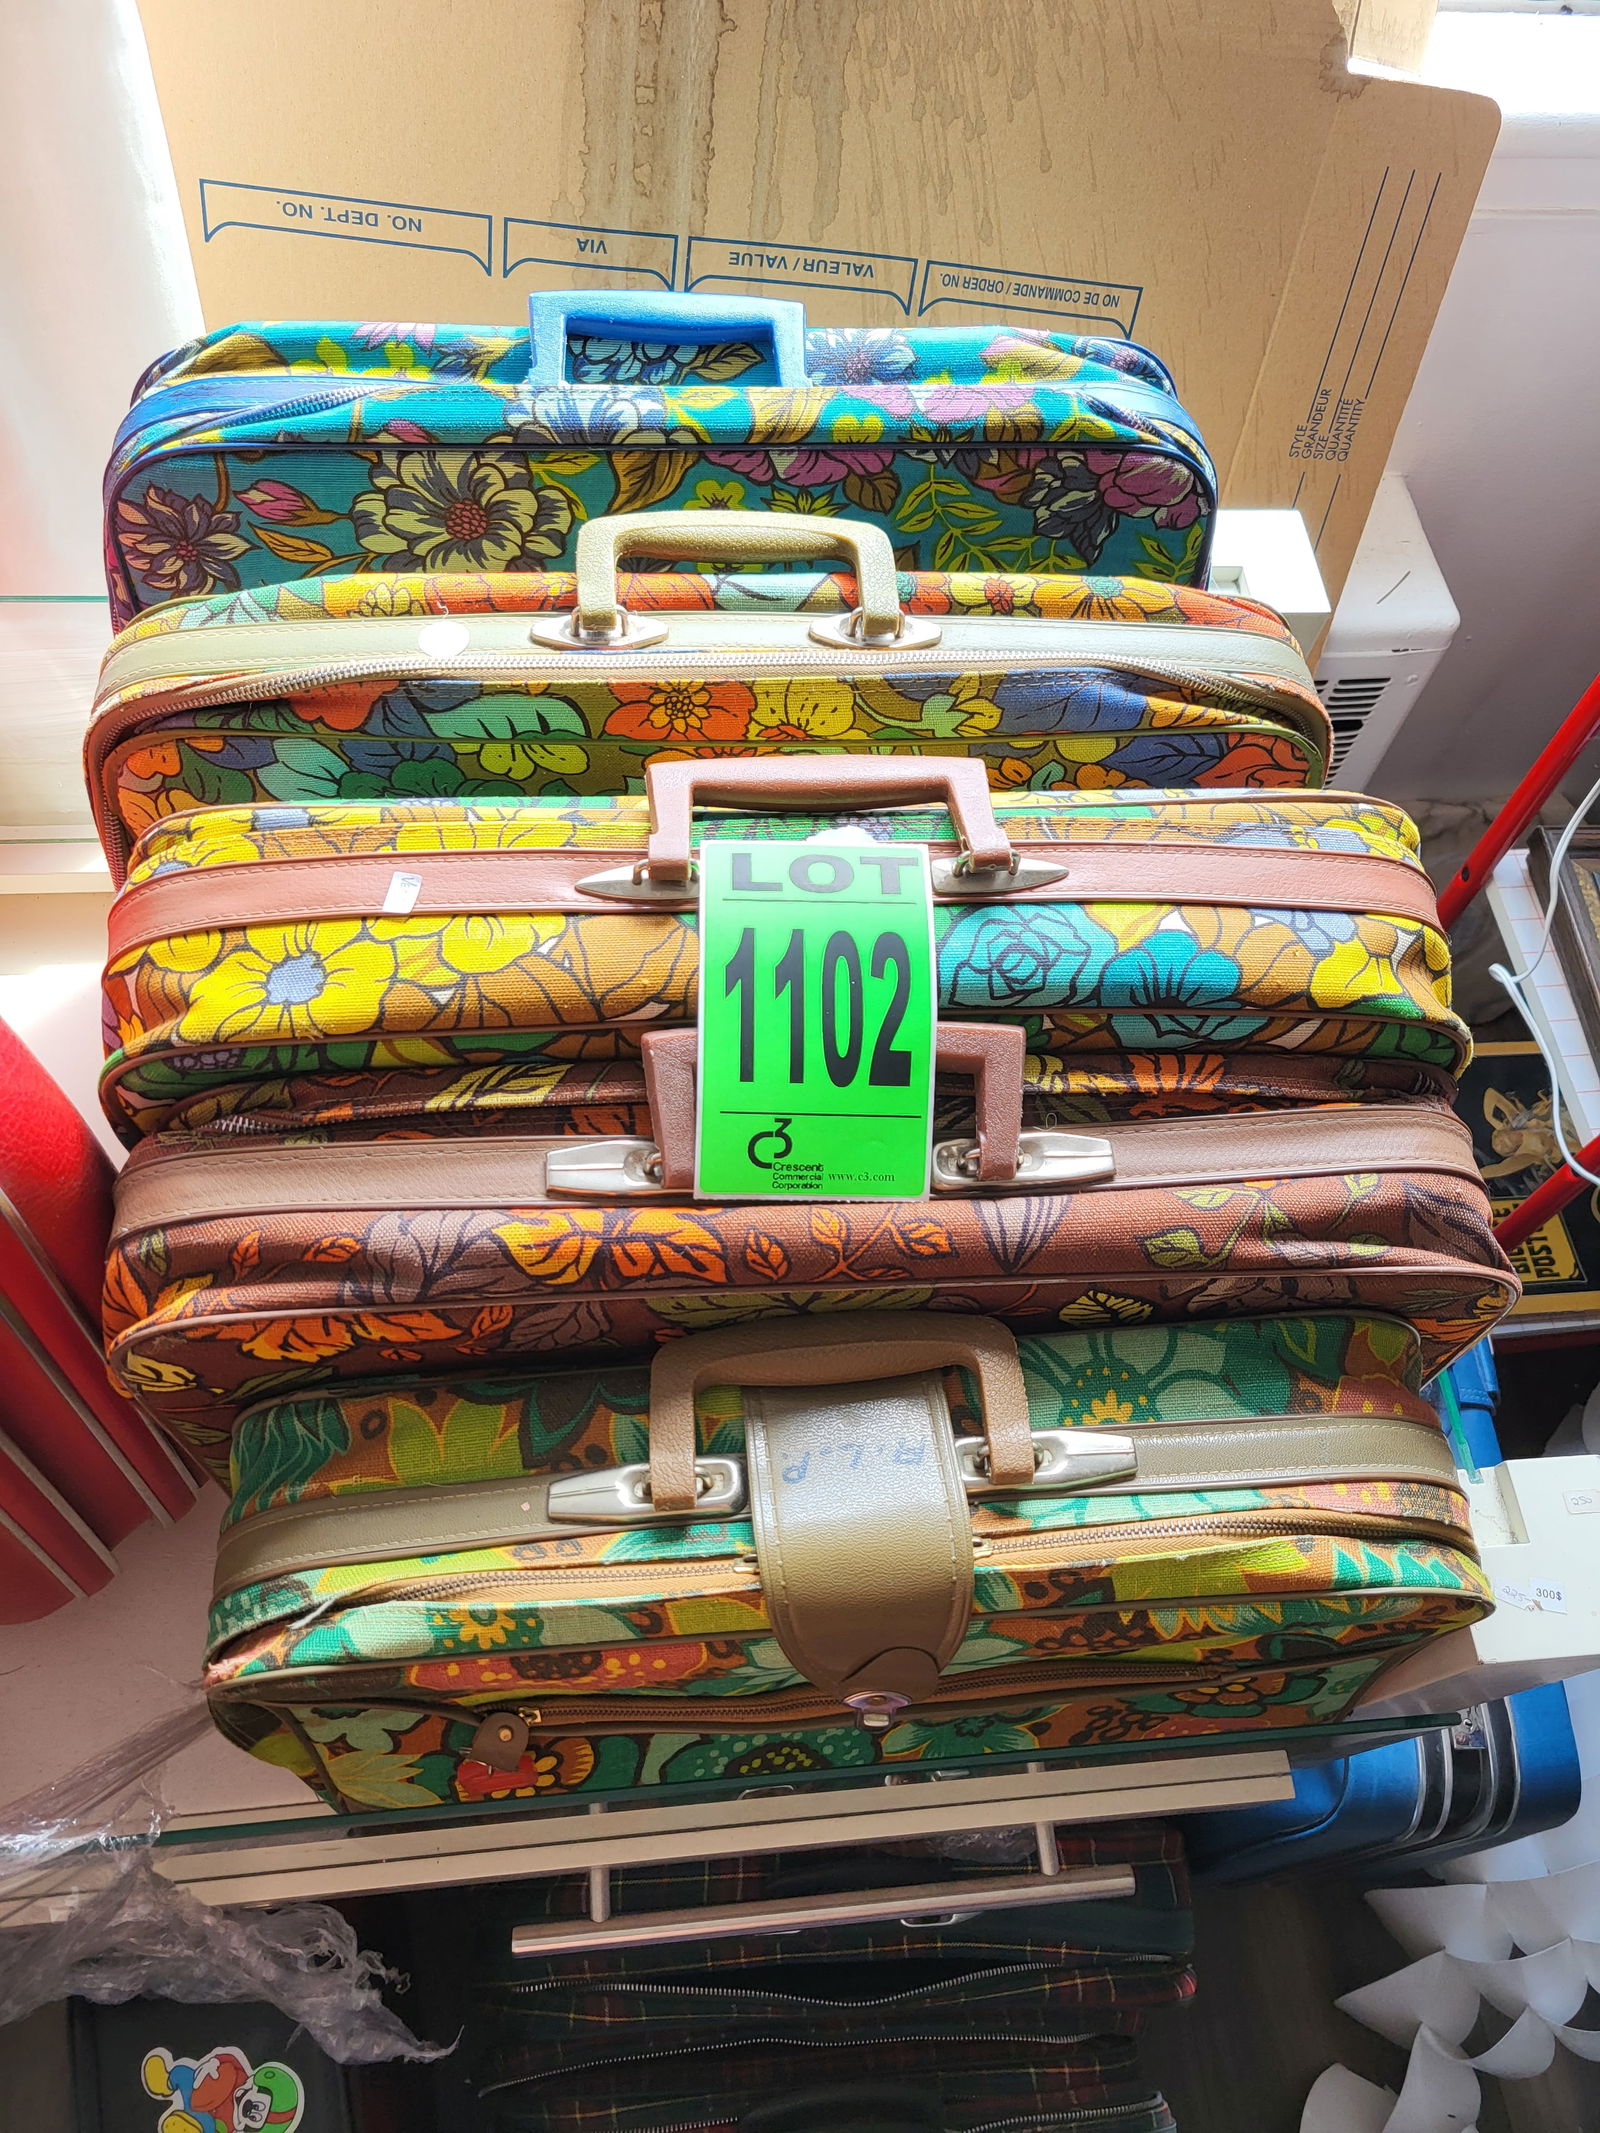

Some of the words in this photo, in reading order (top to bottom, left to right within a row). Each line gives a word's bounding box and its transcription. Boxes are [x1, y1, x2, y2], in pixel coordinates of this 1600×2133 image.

[276, 200, 314, 219] NO.
[321, 205, 379, 228] DEPT.
[386, 213, 423, 232] NO.
[576, 236, 608, 255] VIA
[728, 251, 788, 272] VALUE
[803, 258, 875, 279] VALEUR
[939, 272, 960, 288] NO.
[962, 275, 1004, 294] ORDER
[1012, 281, 1081, 304] COMMANDE
[1083, 291, 1101, 306] DE
[1102, 293, 1121, 309] NO
[1301, 388, 1333, 459] GRANDEUR
[1337, 398, 1366, 462] QUANTITY
[1288, 424, 1308, 458] STYLE
[1312, 434, 1330, 460] SIZE
[731, 852, 919, 895] LOT
[725, 927, 912, 1088] 1102
[772, 1161, 824, 1172] Crescent
[771, 1181, 824, 1191] Corporation
[772, 1172, 824, 1181] Commercial
[828, 1171, 896, 1182] www.c3.com
[1535, 1587, 1563, 1601] 300$
